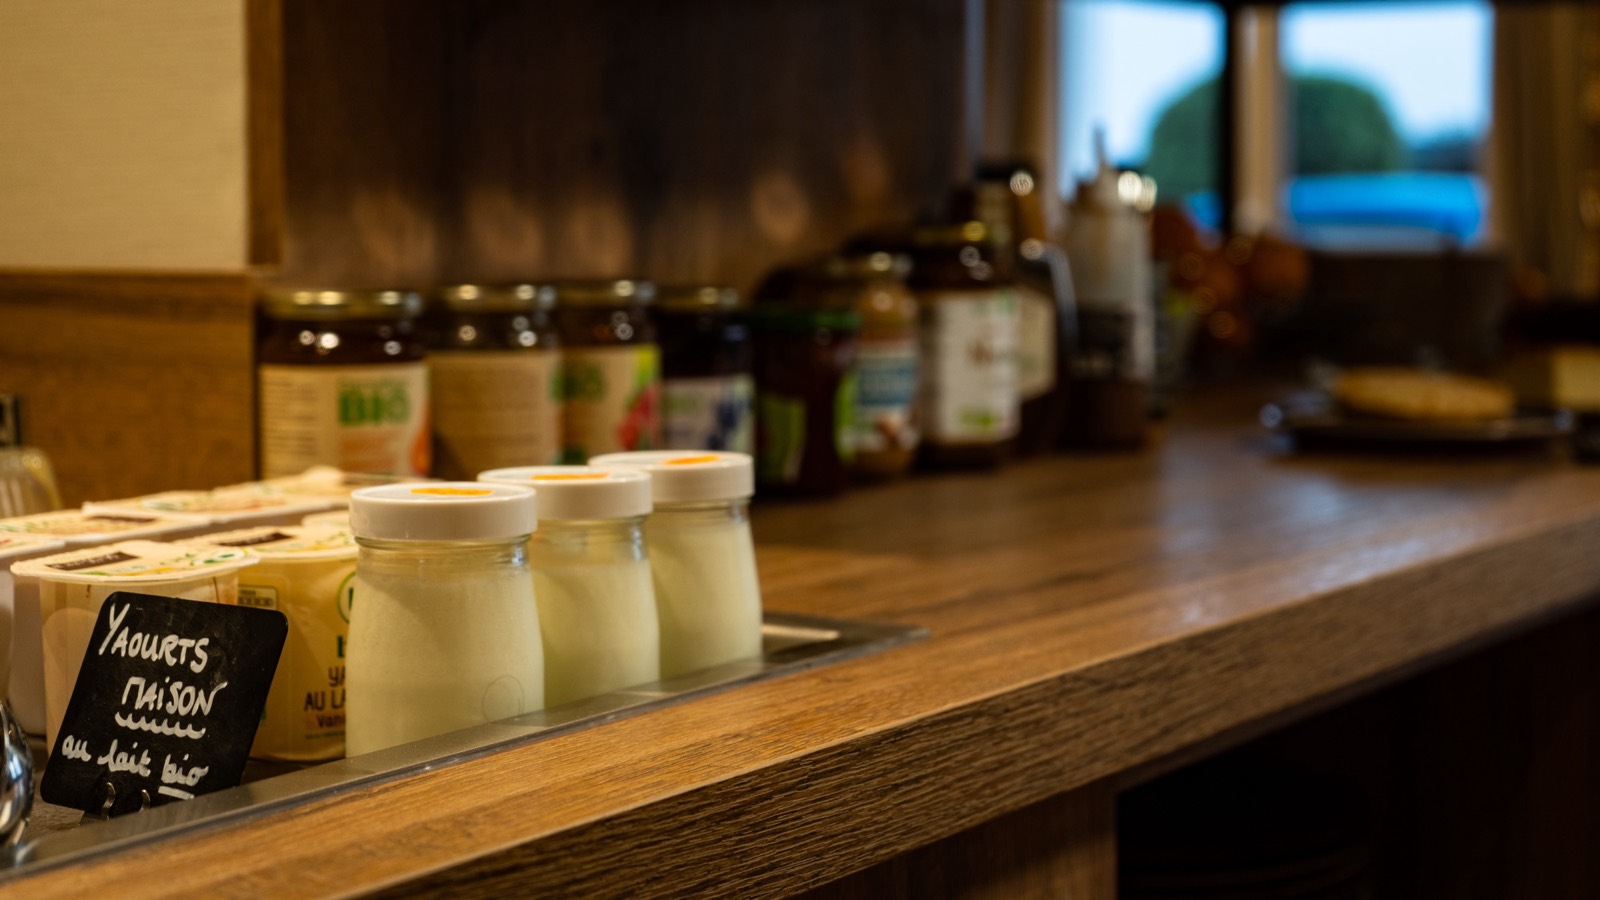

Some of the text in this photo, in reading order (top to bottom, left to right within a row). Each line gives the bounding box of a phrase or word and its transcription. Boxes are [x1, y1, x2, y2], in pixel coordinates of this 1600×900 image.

[98, 602, 210, 674] YAOURTS
[303, 690, 325, 713] AU
[61, 734, 209, 787] au lait bio
